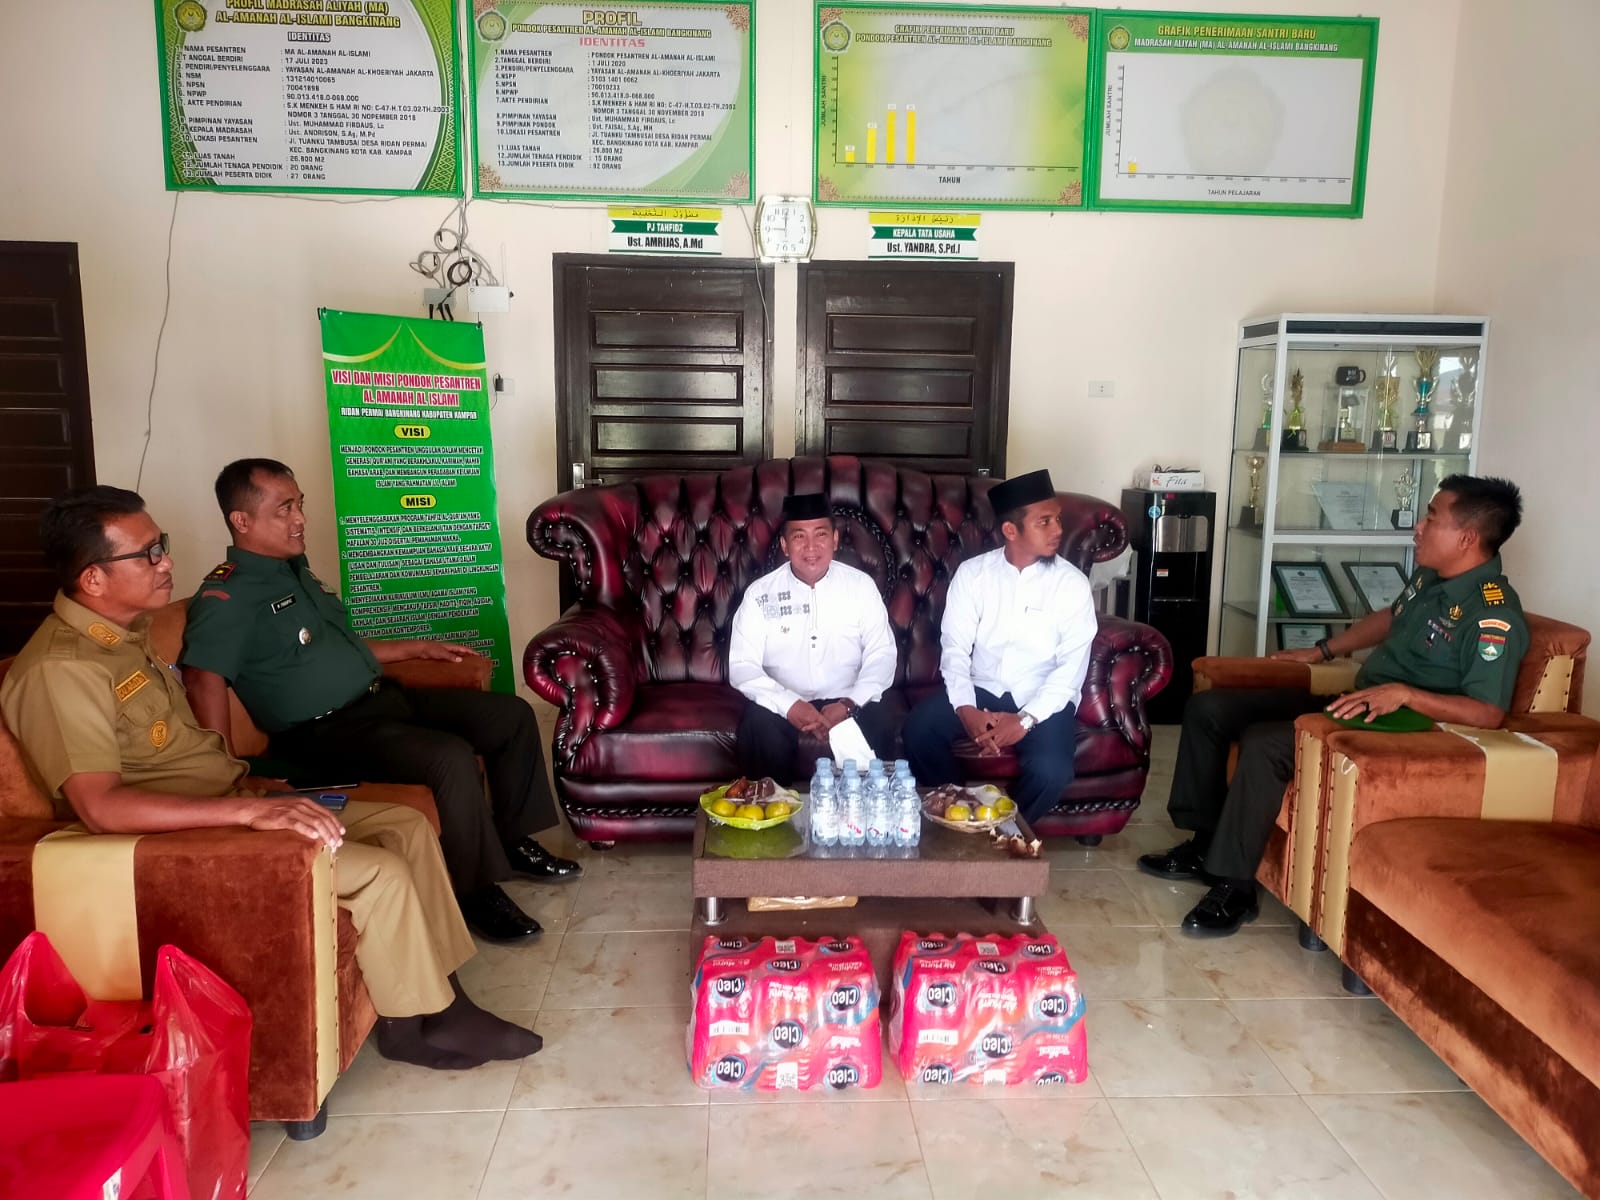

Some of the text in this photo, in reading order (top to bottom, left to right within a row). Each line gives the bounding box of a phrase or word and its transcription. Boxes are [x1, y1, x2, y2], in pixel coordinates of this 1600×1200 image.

[266, 0, 323, 12] MADRASAH
[326, 1, 361, 12] ALIYAH
[364, 2, 389, 14] (MA)
[216, 11, 400, 28] AL-AMANAH AL-ISLAMI BANGKINANG
[583, 10, 642, 26] PROFIL
[288, 31, 330, 42] IDENTITAS
[512, 23, 711, 38] PONDOK PESANTREN AL-AMANAH AL-ISLAMI BANGKINANG
[895, 24, 1014, 36] GRAFIK PENERIMAAN SANTRI BARU
[1158, 26, 1316, 39] GRAFIK PENERIMAAN SANTRI BARU
[579, 37, 646, 48] IDENTITAS
[855, 34, 1052, 47] PONDOK PESANTREN AL-AMANAH AL-ISLAMI BANGKINANG
[1135, 38, 1337, 52] MADRASAH ALIYAH (MA) AL-AMANAH AL-ISLAMI BANGKINANG
[207, 46, 246, 54] PESANTREN
[185, 64, 270, 72] PENDIRI/PENYELENGGARA
[346, 121, 375, 129] FIRDAUS,
[939, 176, 961, 184] TAHUN
[647, 223, 683, 232] PJ TAHFIDZ
[893, 229, 955, 238] KEPALA TATA USAHA
[627, 236, 703, 249] Ust. AMRIJAS, A.Md
[887, 242, 960, 254] Ust. YANDRA, S.Pd.I
[332, 370, 481, 390] VISI DAN MISI PONDOK PESANTREN
[363, 390, 459, 406] AL AMANAH AL ISLAMI
[341, 407, 360, 416] RIDAN
[384, 408, 420, 418] BANGKINANG
[421, 410, 451, 419] KABUPATEN
[402, 428, 424, 436] VISI
[406, 497, 430, 506] MISI
[718, 979, 742, 993] Cleo
[832, 991, 858, 1004] Cleo
[928, 988, 954, 1001] Cleo
[1041, 998, 1065, 1012] Cleo
[775, 1027, 800, 1040] Cleo
[982, 1038, 1008, 1053] Cleo
[717, 1063, 742, 1077] Cleo
[830, 1070, 855, 1083] Cleo
[924, 1069, 950, 1082] Cleo
